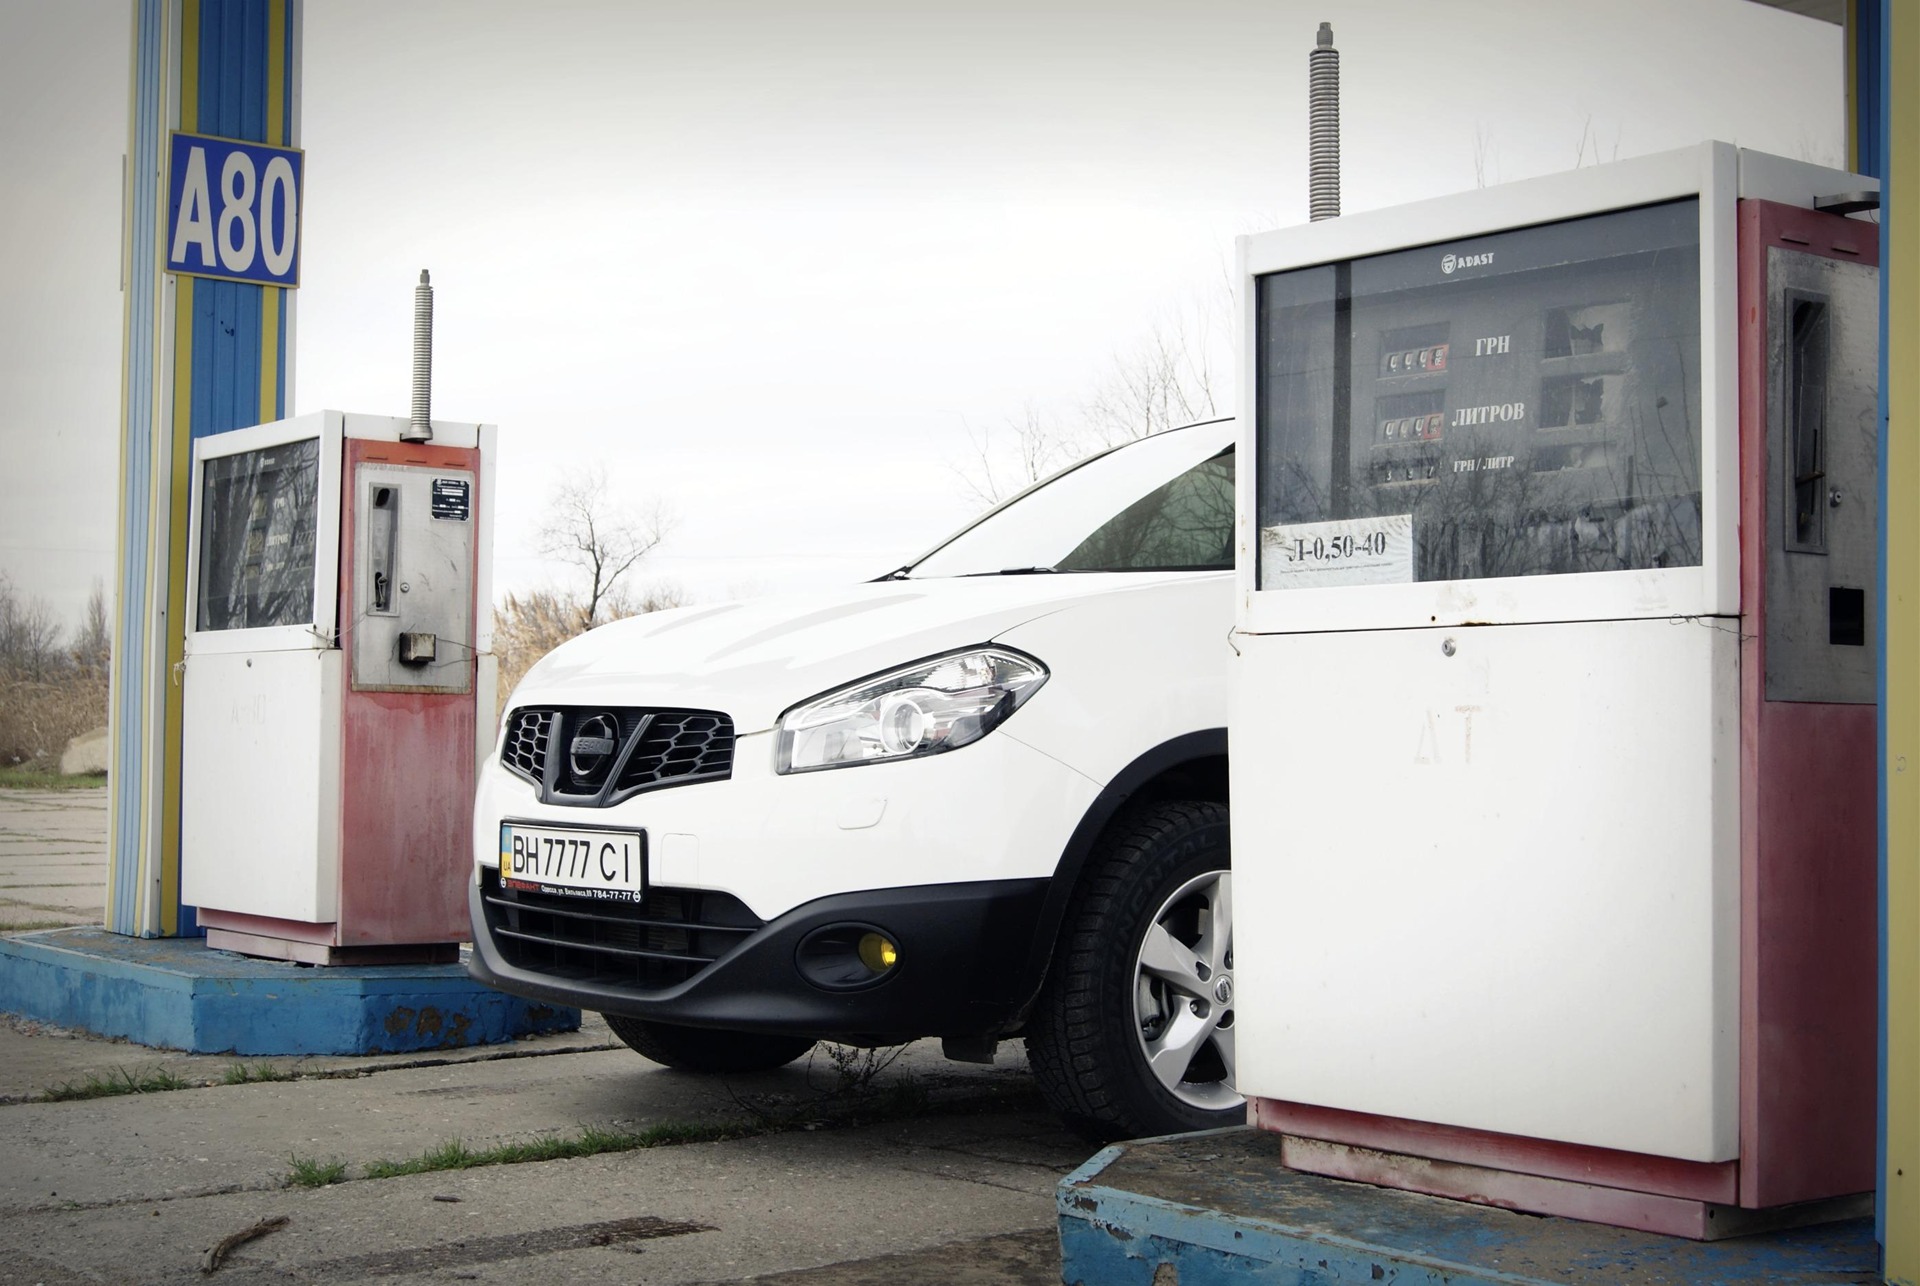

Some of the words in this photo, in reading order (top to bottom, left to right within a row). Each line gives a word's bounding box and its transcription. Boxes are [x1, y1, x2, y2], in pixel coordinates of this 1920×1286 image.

[171, 146, 297, 276] А80
[1457, 252, 1495, 269] ADAST
[1475, 335, 1511, 357] ГРН
[1451, 402, 1525, 427] ЛИТРОВ
[503, 861, 512, 872] UA
[513, 835, 539, 875] BH
[543, 838, 591, 879] 7777
[599, 842, 629, 883] CI
[592, 889, 632, 901] 784-77-77
